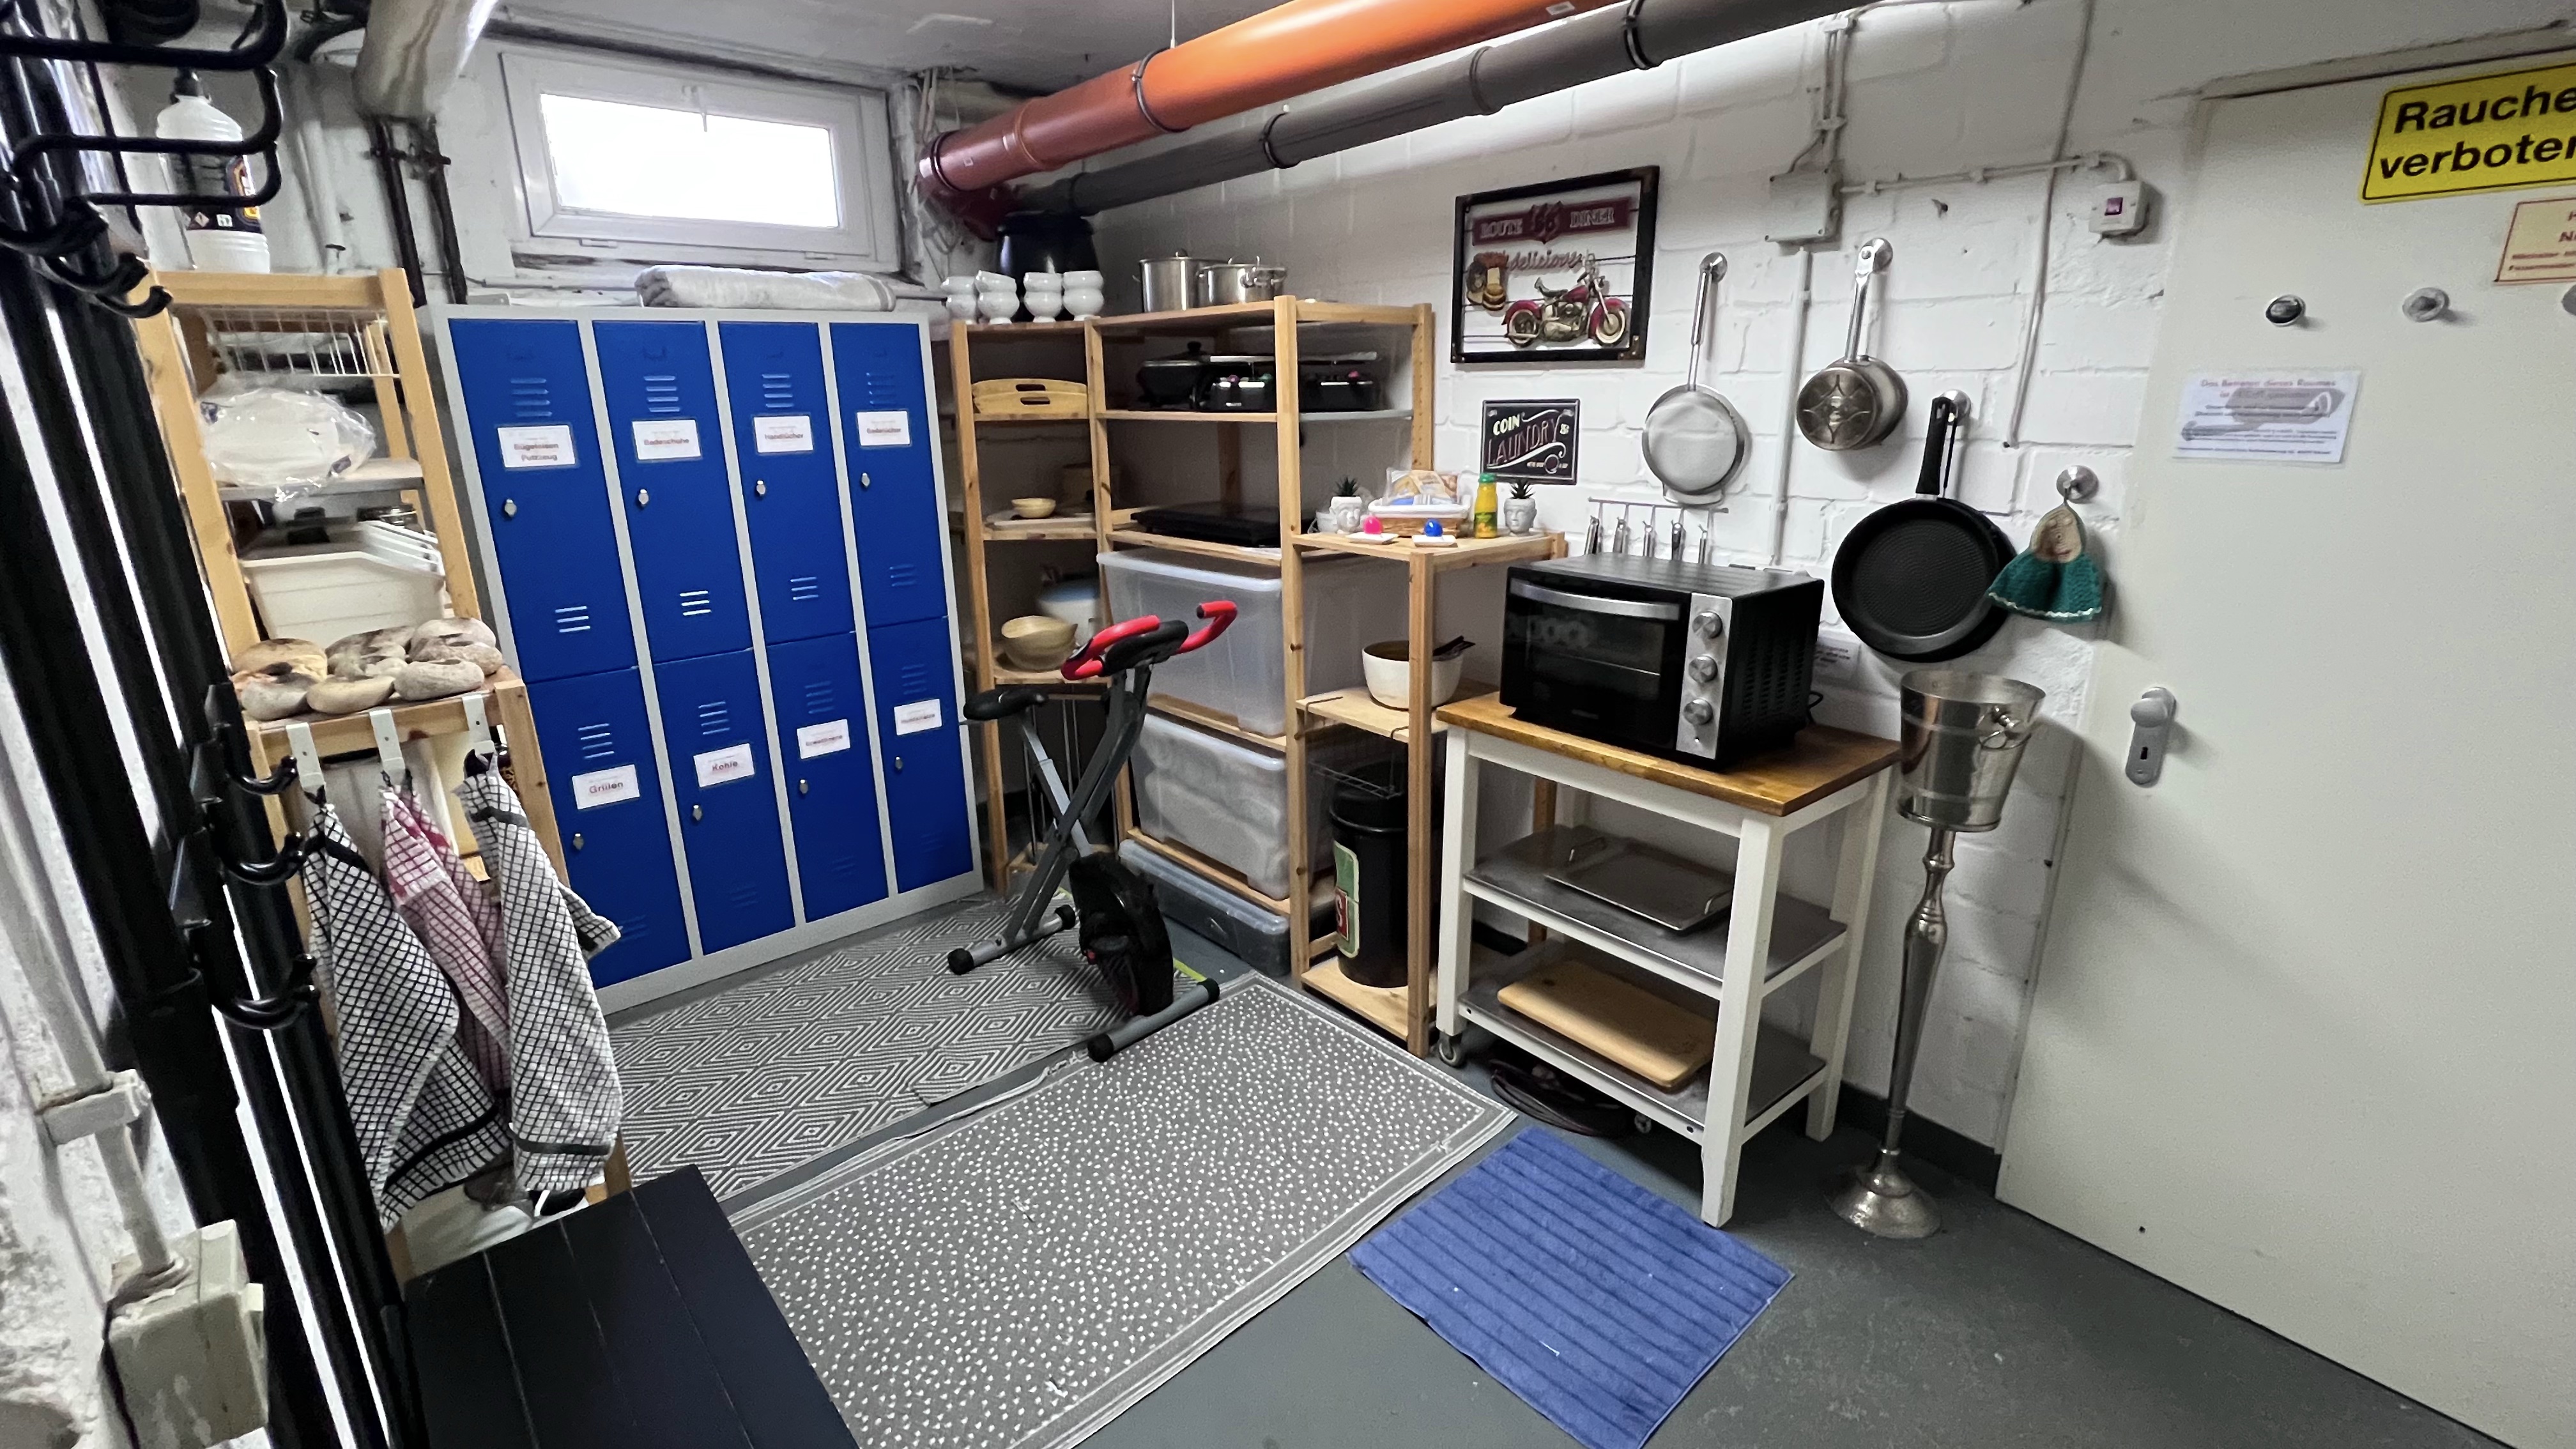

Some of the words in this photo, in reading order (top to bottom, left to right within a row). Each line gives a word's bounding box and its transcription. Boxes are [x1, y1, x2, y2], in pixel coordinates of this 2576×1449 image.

[1480, 218, 1523, 238] ROUTE
[1569, 207, 1615, 228] DINER
[1493, 414, 1520, 435] COIN
[1487, 413, 1563, 466] LAUNDRY
[712, 760, 738, 772] Kohle
[589, 781, 624, 793] Grillen
